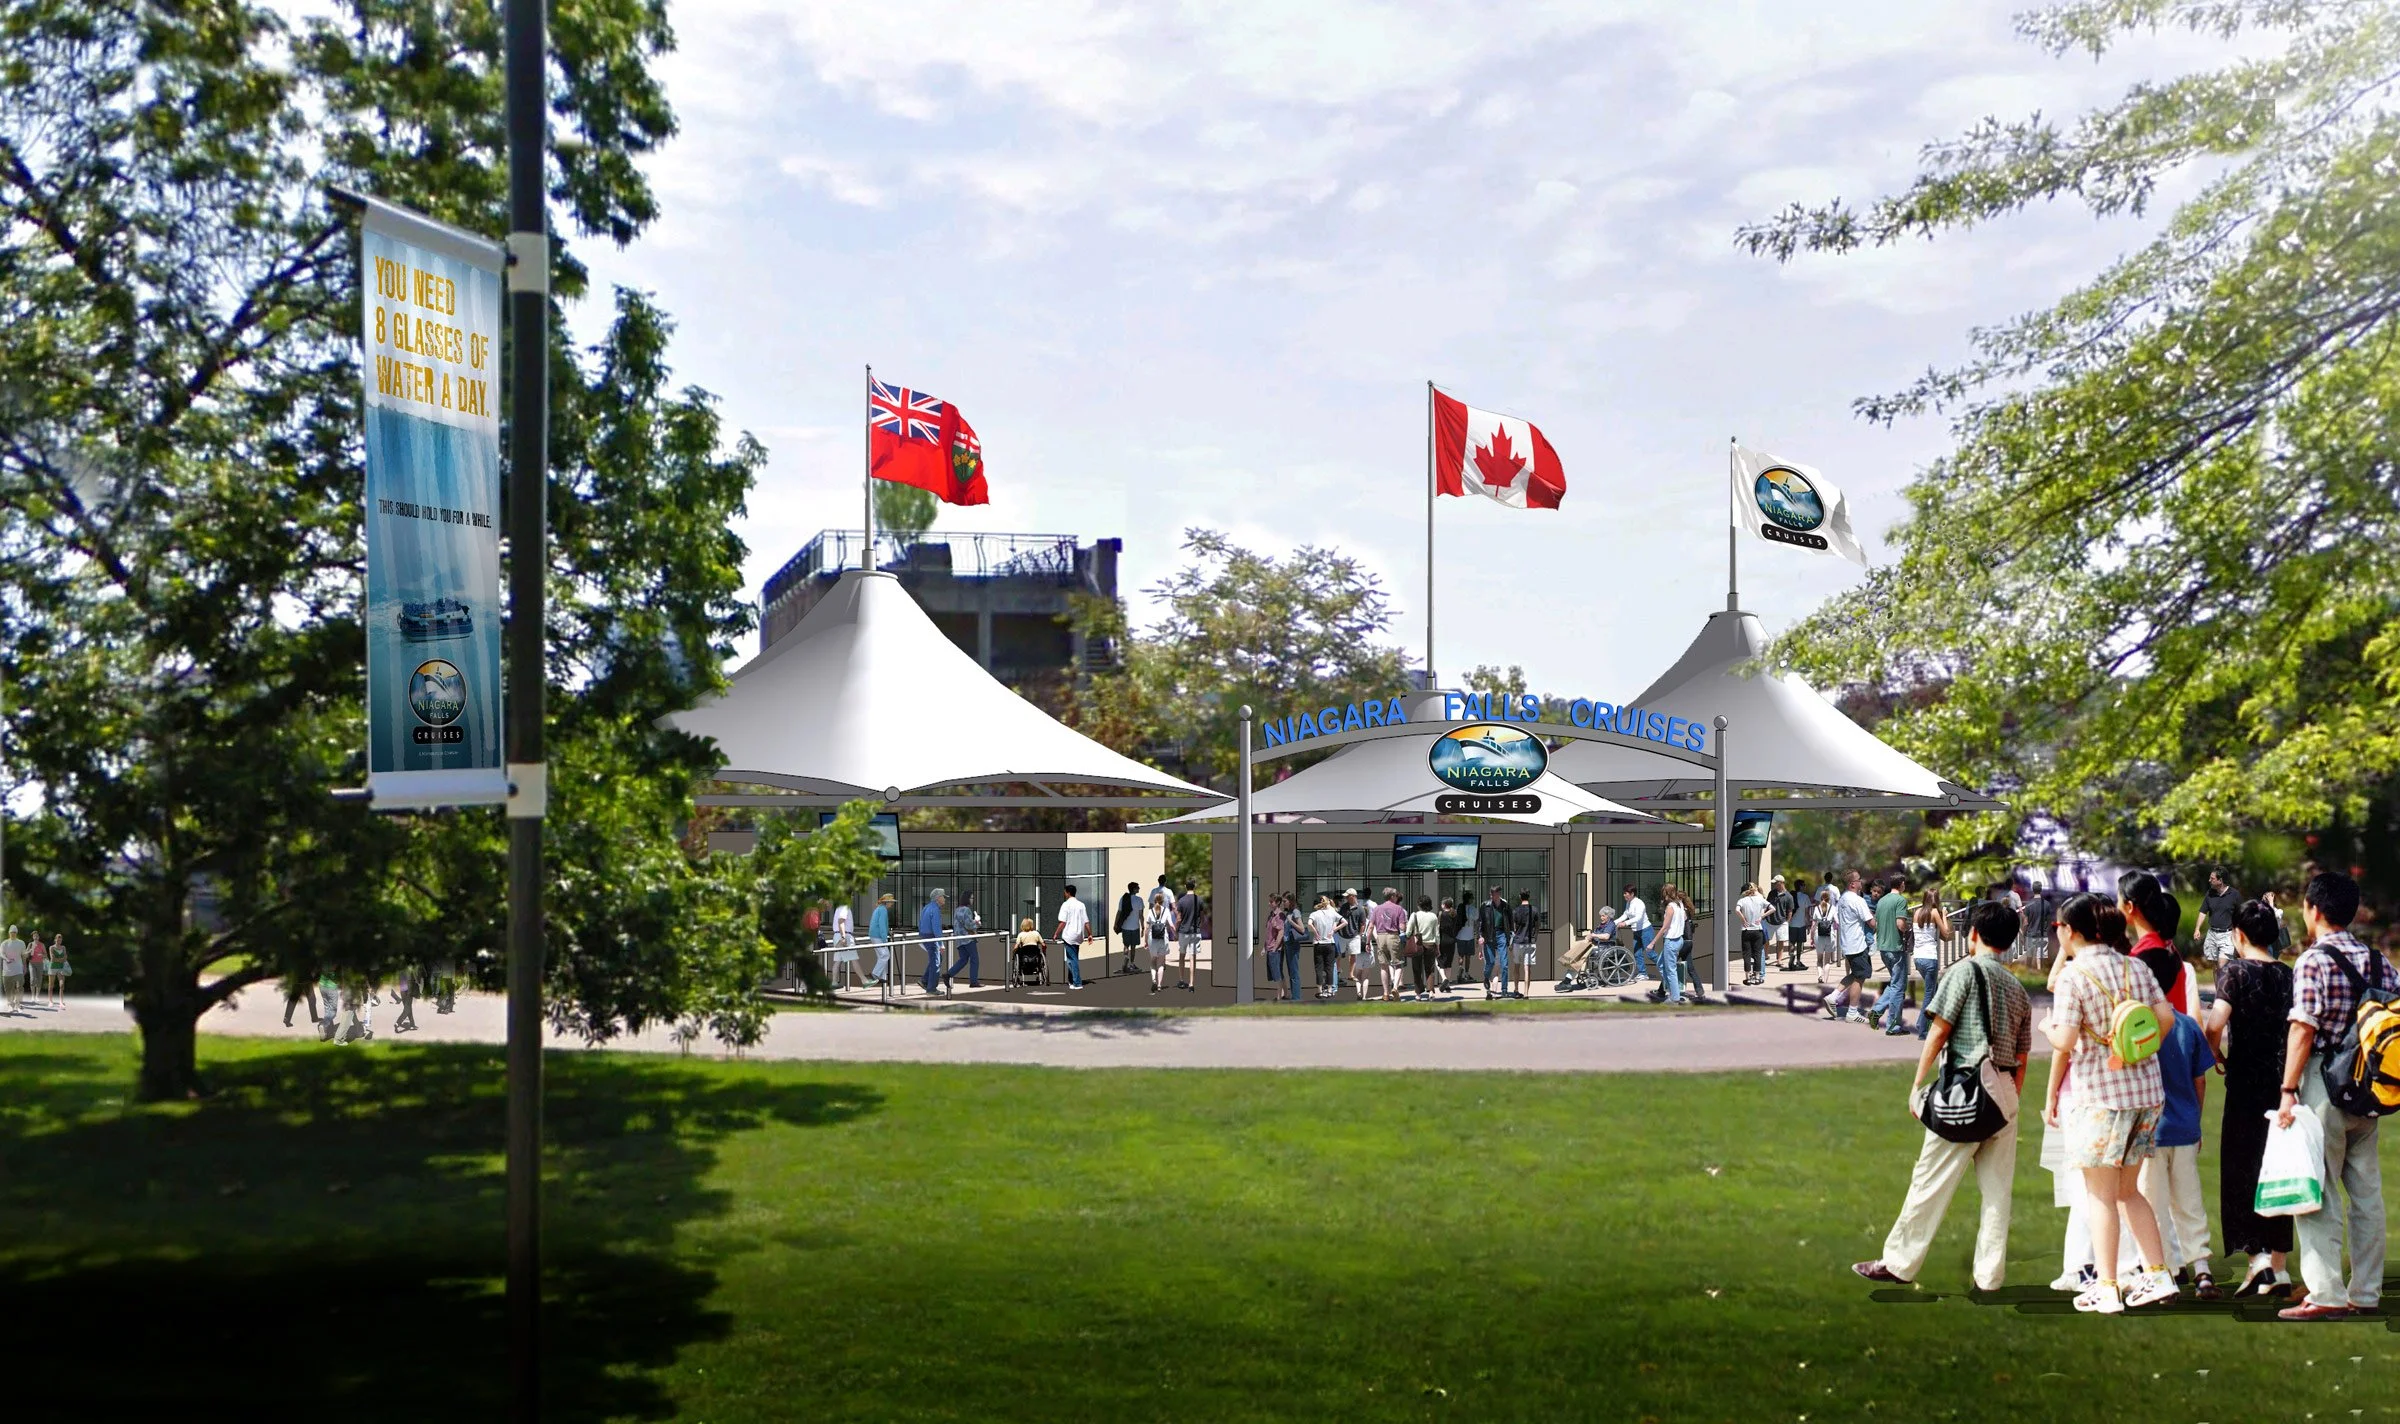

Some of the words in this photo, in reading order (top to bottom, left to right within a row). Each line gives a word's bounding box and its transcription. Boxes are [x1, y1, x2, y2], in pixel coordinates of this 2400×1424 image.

[375, 255, 407, 302] YOU
[414, 268, 455, 316] NEED
[375, 306, 386, 344] 8
[394, 312, 463, 364] GLASSES
[470, 333, 489, 371] OF
[376, 354, 434, 405] WATER
[441, 373, 452, 409] A
[458, 376, 490, 418] DAY.
[378, 499, 394, 515] THIS
[396, 502, 419, 519] SHOULD
[422, 505, 438, 521] HOLD
[440, 508, 451, 523] YOU
[453, 510, 463, 525] FOR
[466, 512, 470, 526] A
[472, 512, 492, 529] WHILE.
[1764, 503, 1815, 525] NIAGARA
[1779, 517, 1803, 528] FALLS
[1767, 529, 1822, 546] CRUISES
[418, 700, 459, 711] NIAGARA
[1263, 697, 1407, 749] NIAGARA
[1444, 693, 1540, 722] FALLS
[1570, 699, 1707, 753] CRUISES
[417, 731, 460, 740] CRUISES
[1446, 766, 1531, 779] NIAGARA
[1470, 779, 1510, 787] FALLS
[1444, 799, 1533, 810] CRUISES
